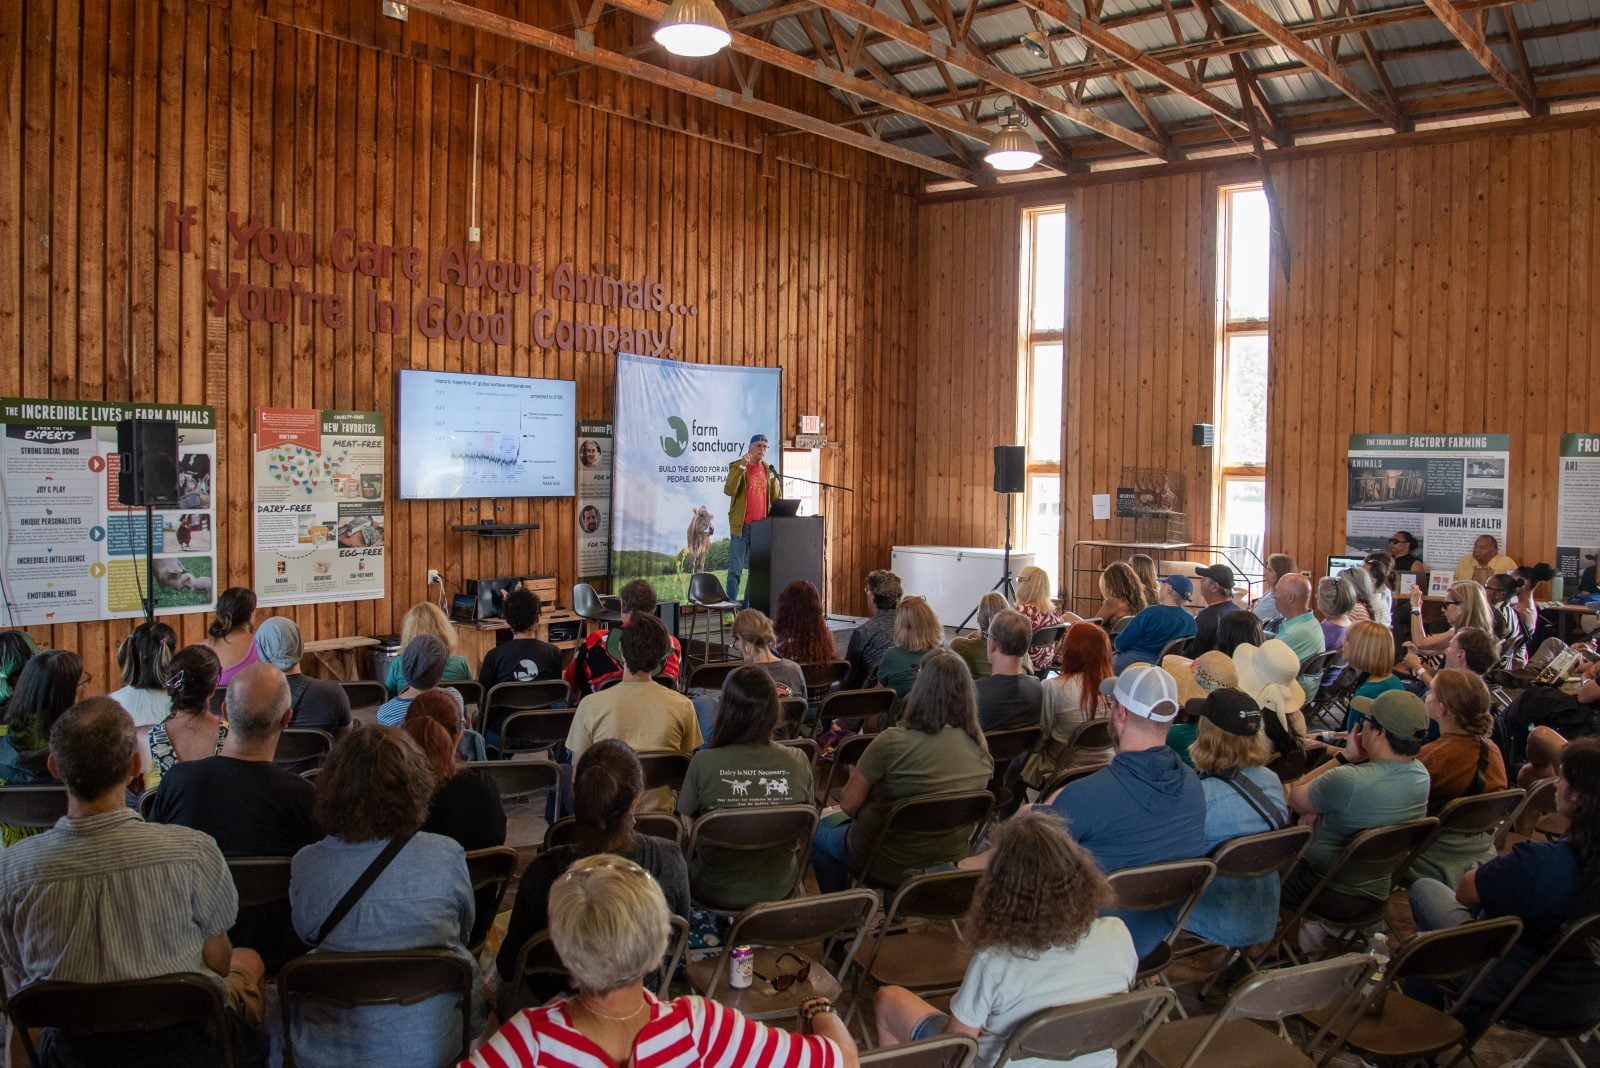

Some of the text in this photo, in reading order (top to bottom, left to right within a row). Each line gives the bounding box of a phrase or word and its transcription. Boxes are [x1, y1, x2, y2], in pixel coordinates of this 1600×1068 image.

[164, 201, 198, 254] If
[227, 210, 311, 267] You
[330, 228, 422, 281] Care
[440, 247, 539, 296] About
[206, 268, 677, 360] You're In Good Company!
[5, 406, 19, 416] THE
[21, 404, 88, 421] INCREDIBLE
[91, 406, 122, 421] LIVES
[135, 408, 163, 420] FARM
[166, 409, 209, 425] ANIMALS
[323, 422, 339, 433] NEW
[342, 423, 376, 434] FAVORITES
[692, 419, 718, 436] farm
[805, 416, 817, 431] EXIT
[24, 430, 76, 440] EXPERTS
[332, 439, 382, 448] MEAT-FREE
[692, 439, 745, 456] sanctuary
[1409, 437, 1446, 448] FACTORY
[1448, 437, 1487, 448] FARMING
[20, 447, 41, 455] STRONG
[42, 447, 61, 455] SOCIAL
[1351, 459, 1382, 468] ANIMALS
[667, 475, 691, 483] PEOPLE,
[258, 504, 312, 513] DAIRY-FREE
[20, 516, 82, 526] UNIQUE PERSONALITIES
[1438, 517, 1502, 529] HUMAN HEALTH
[339, 548, 383, 557] EGG-FREE
[17, 555, 86, 565] INCREDIBLE INTELLIGENCE
[27, 590, 77, 600] EMOTIONAL BEINGS
